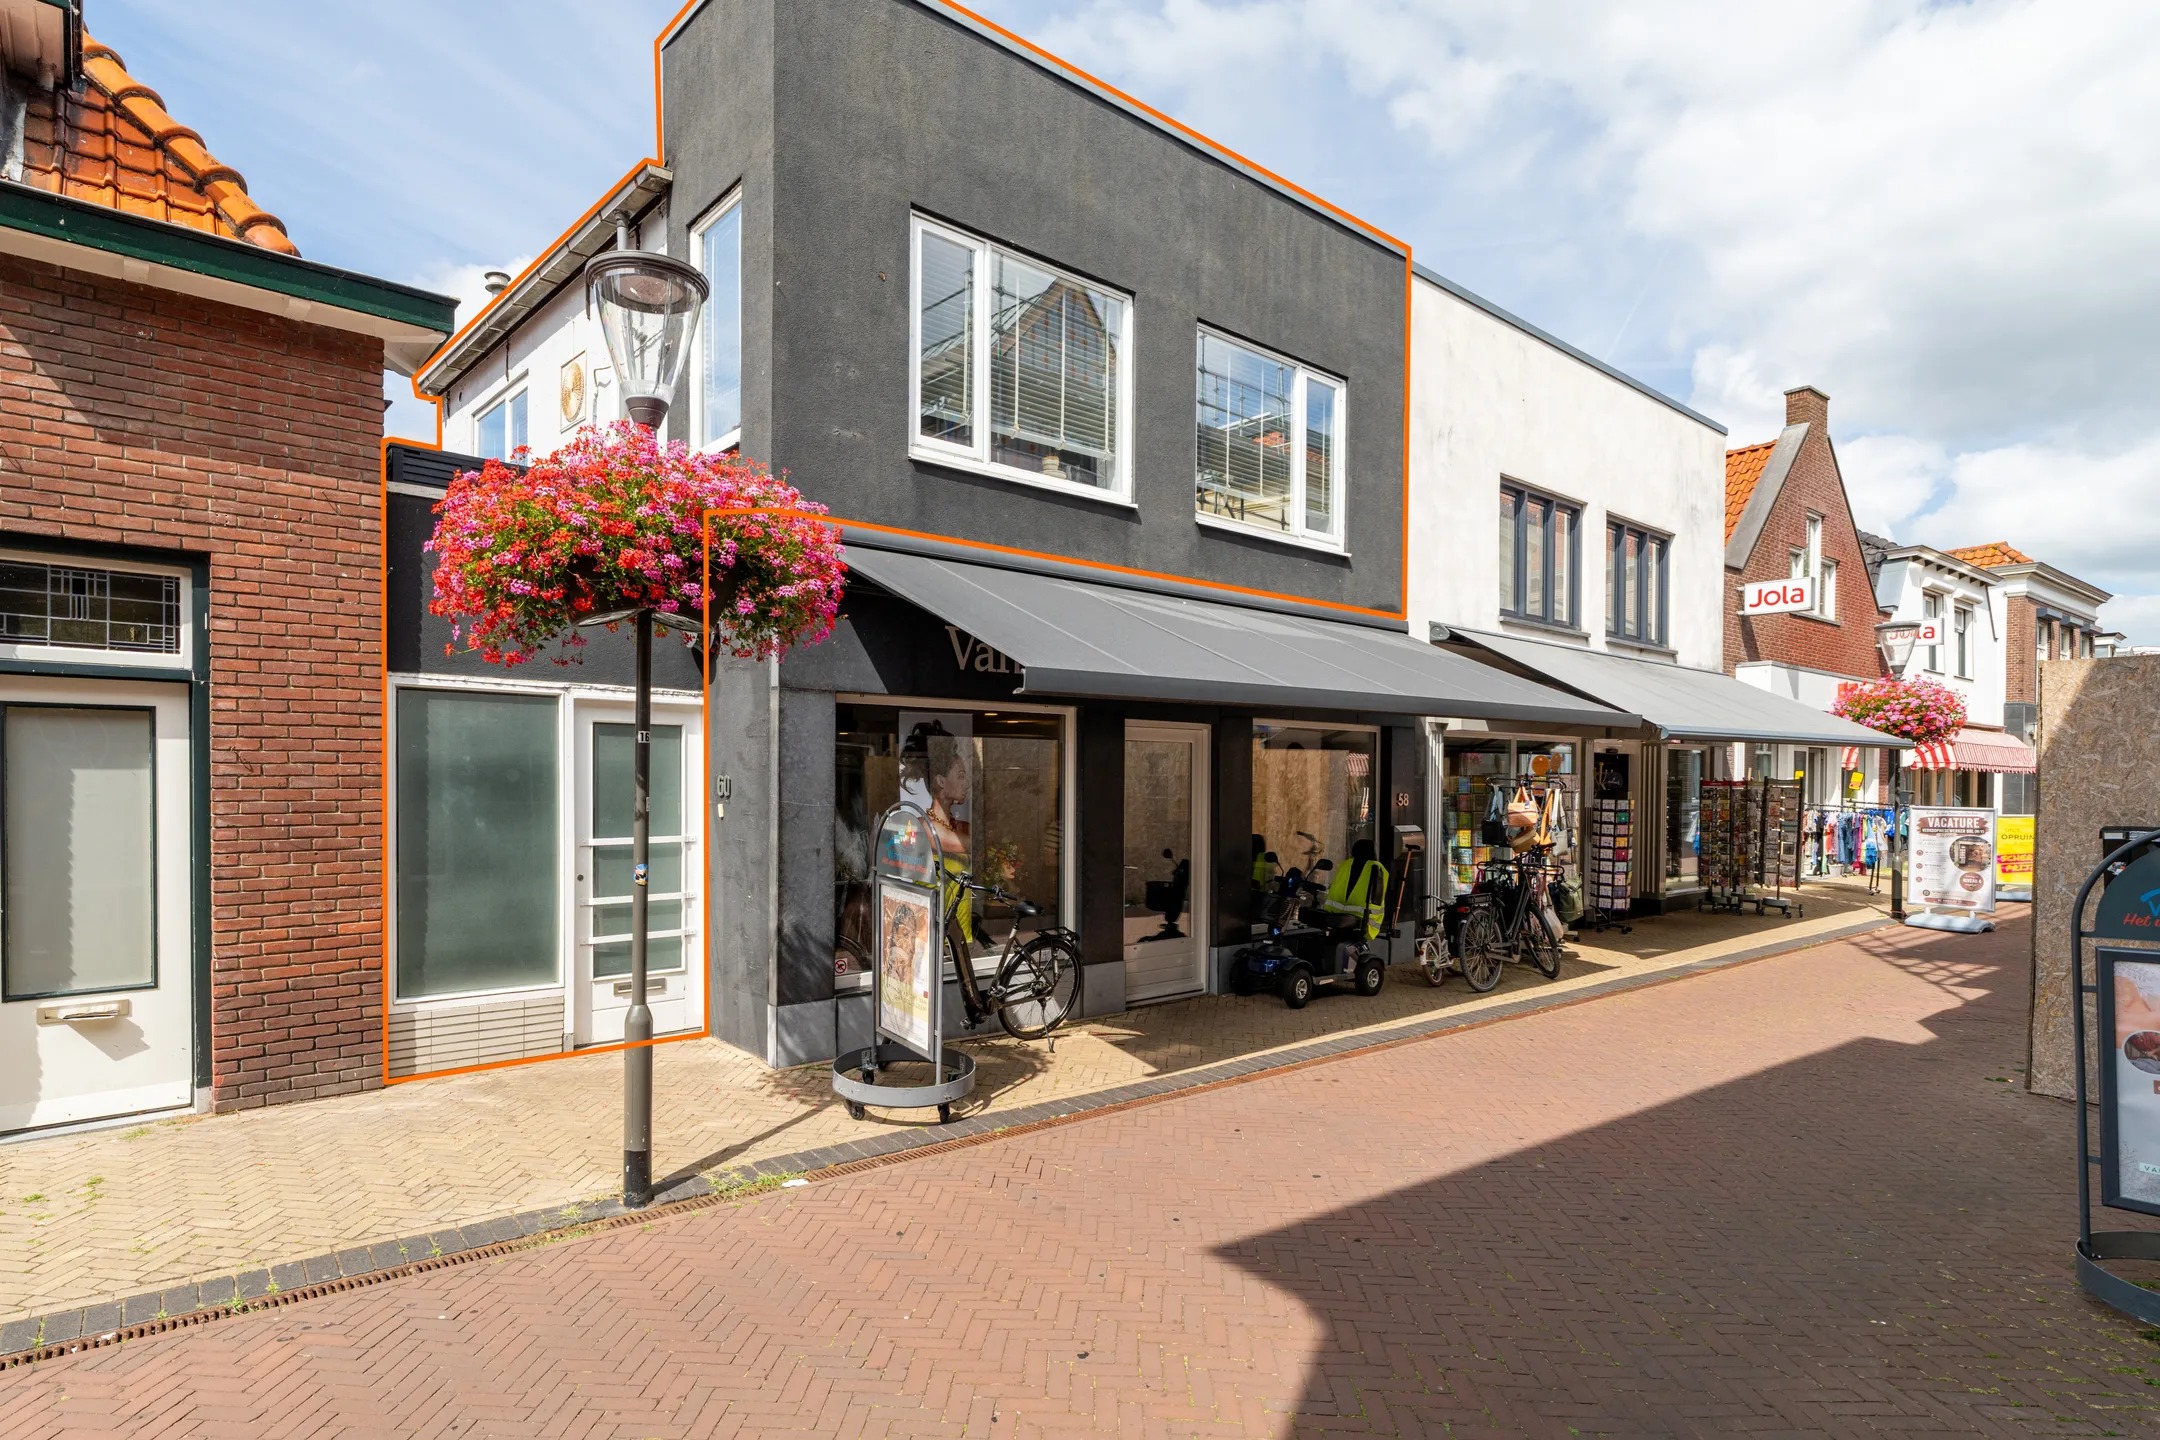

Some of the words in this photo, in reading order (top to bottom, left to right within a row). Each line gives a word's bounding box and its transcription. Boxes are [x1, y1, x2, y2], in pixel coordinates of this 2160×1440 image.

[1749, 586, 1804, 607] Jola
[640, 732, 650, 742] 16
[717, 774, 731, 797] 60
[1398, 793, 1409, 806] 58
[1927, 817, 1980, 828] VACATURE
[2123, 913, 2151, 927] Het
[2144, 1165, 2160, 1173] VA
